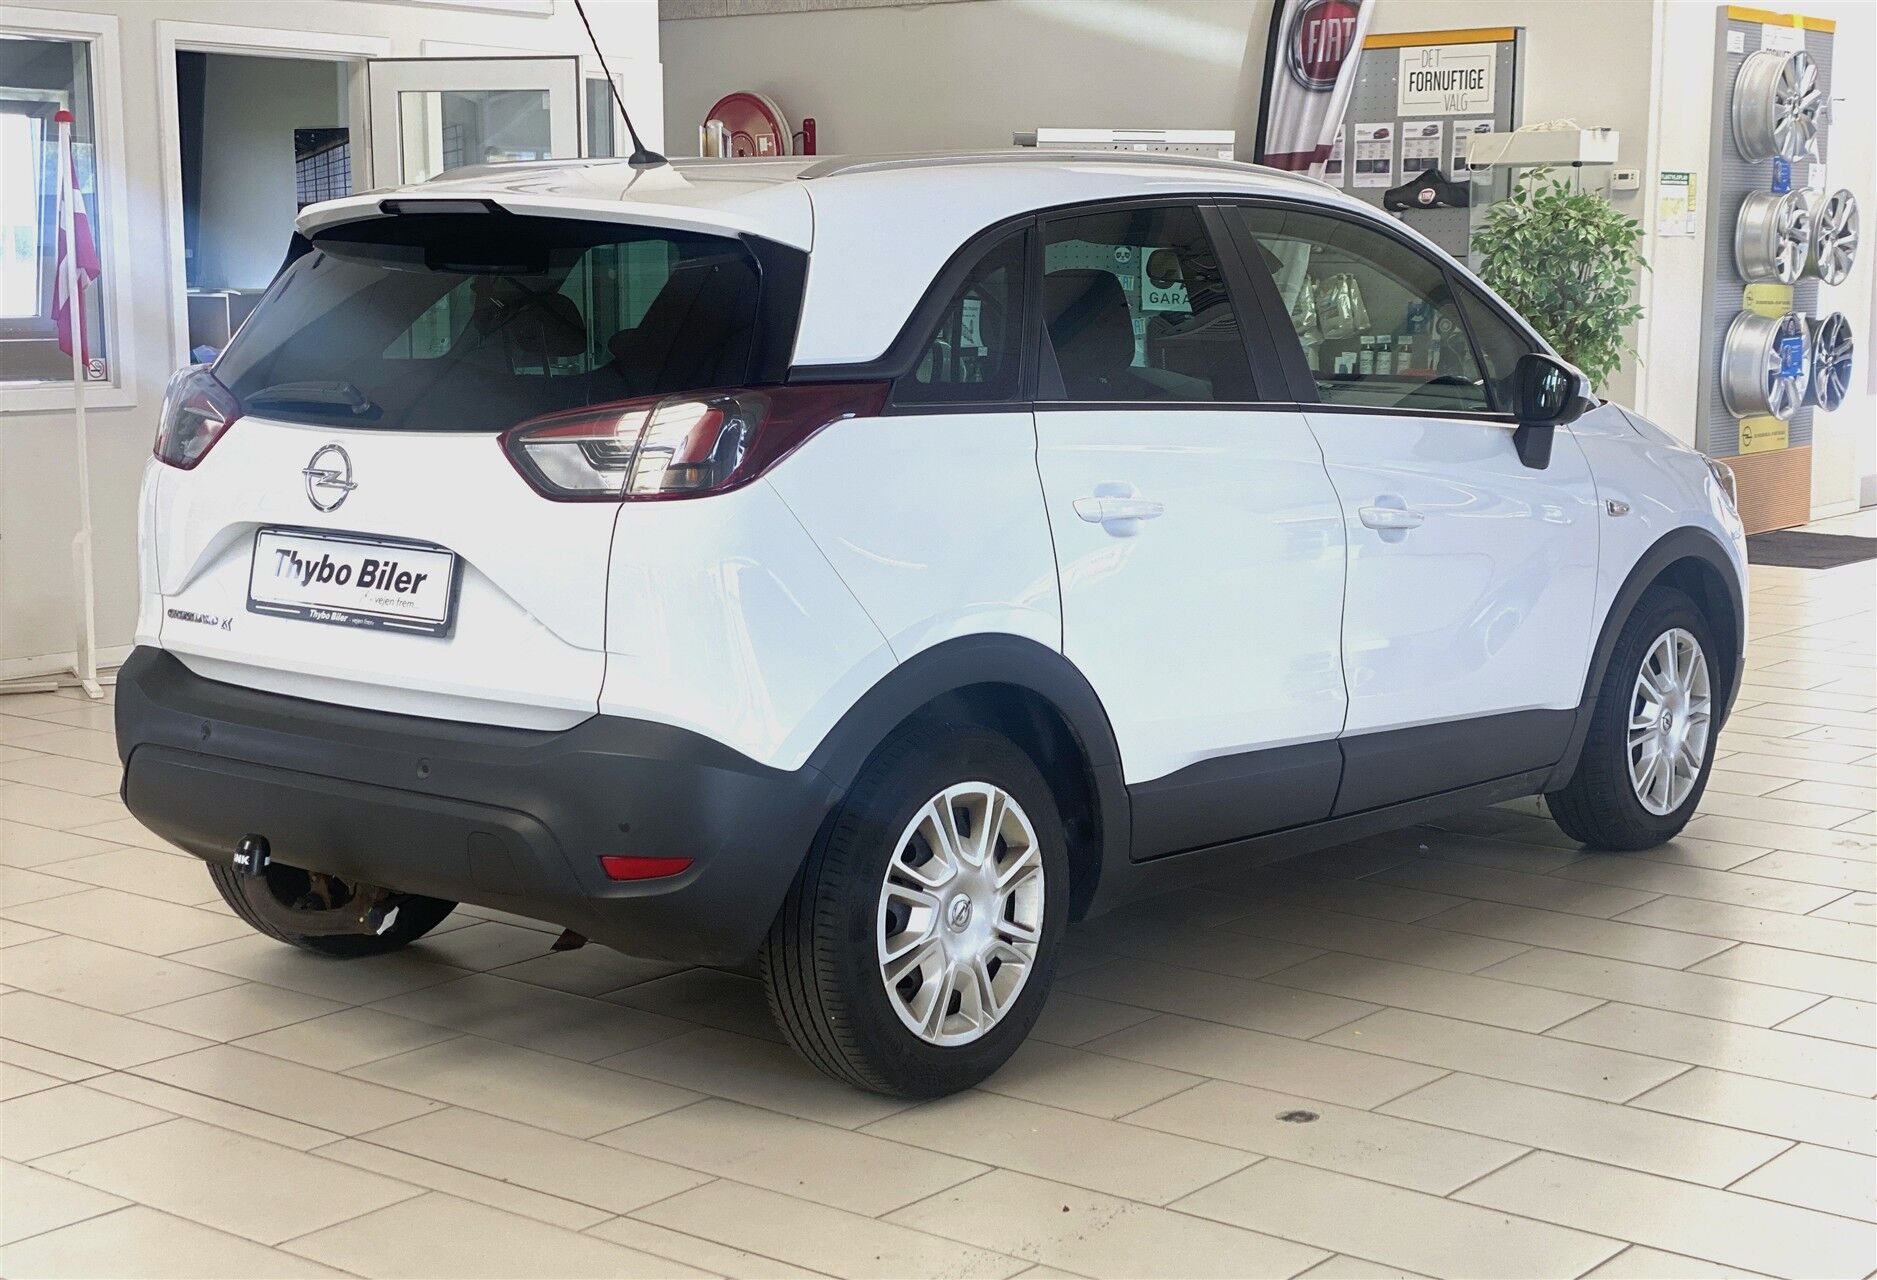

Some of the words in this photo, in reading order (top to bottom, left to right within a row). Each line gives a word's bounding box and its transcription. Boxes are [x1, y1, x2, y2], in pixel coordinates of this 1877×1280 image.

[1307, 17, 1356, 64] FIAT
[1421, 49, 1441, 68] DET
[1408, 68, 1485, 92] FORNUFTIGE
[1443, 93, 1469, 112] VALG
[275, 548, 353, 587] Thybo
[356, 558, 428, 594] Biler
[309, 609, 331, 620] Thybo
[330, 612, 349, 622] Biler
